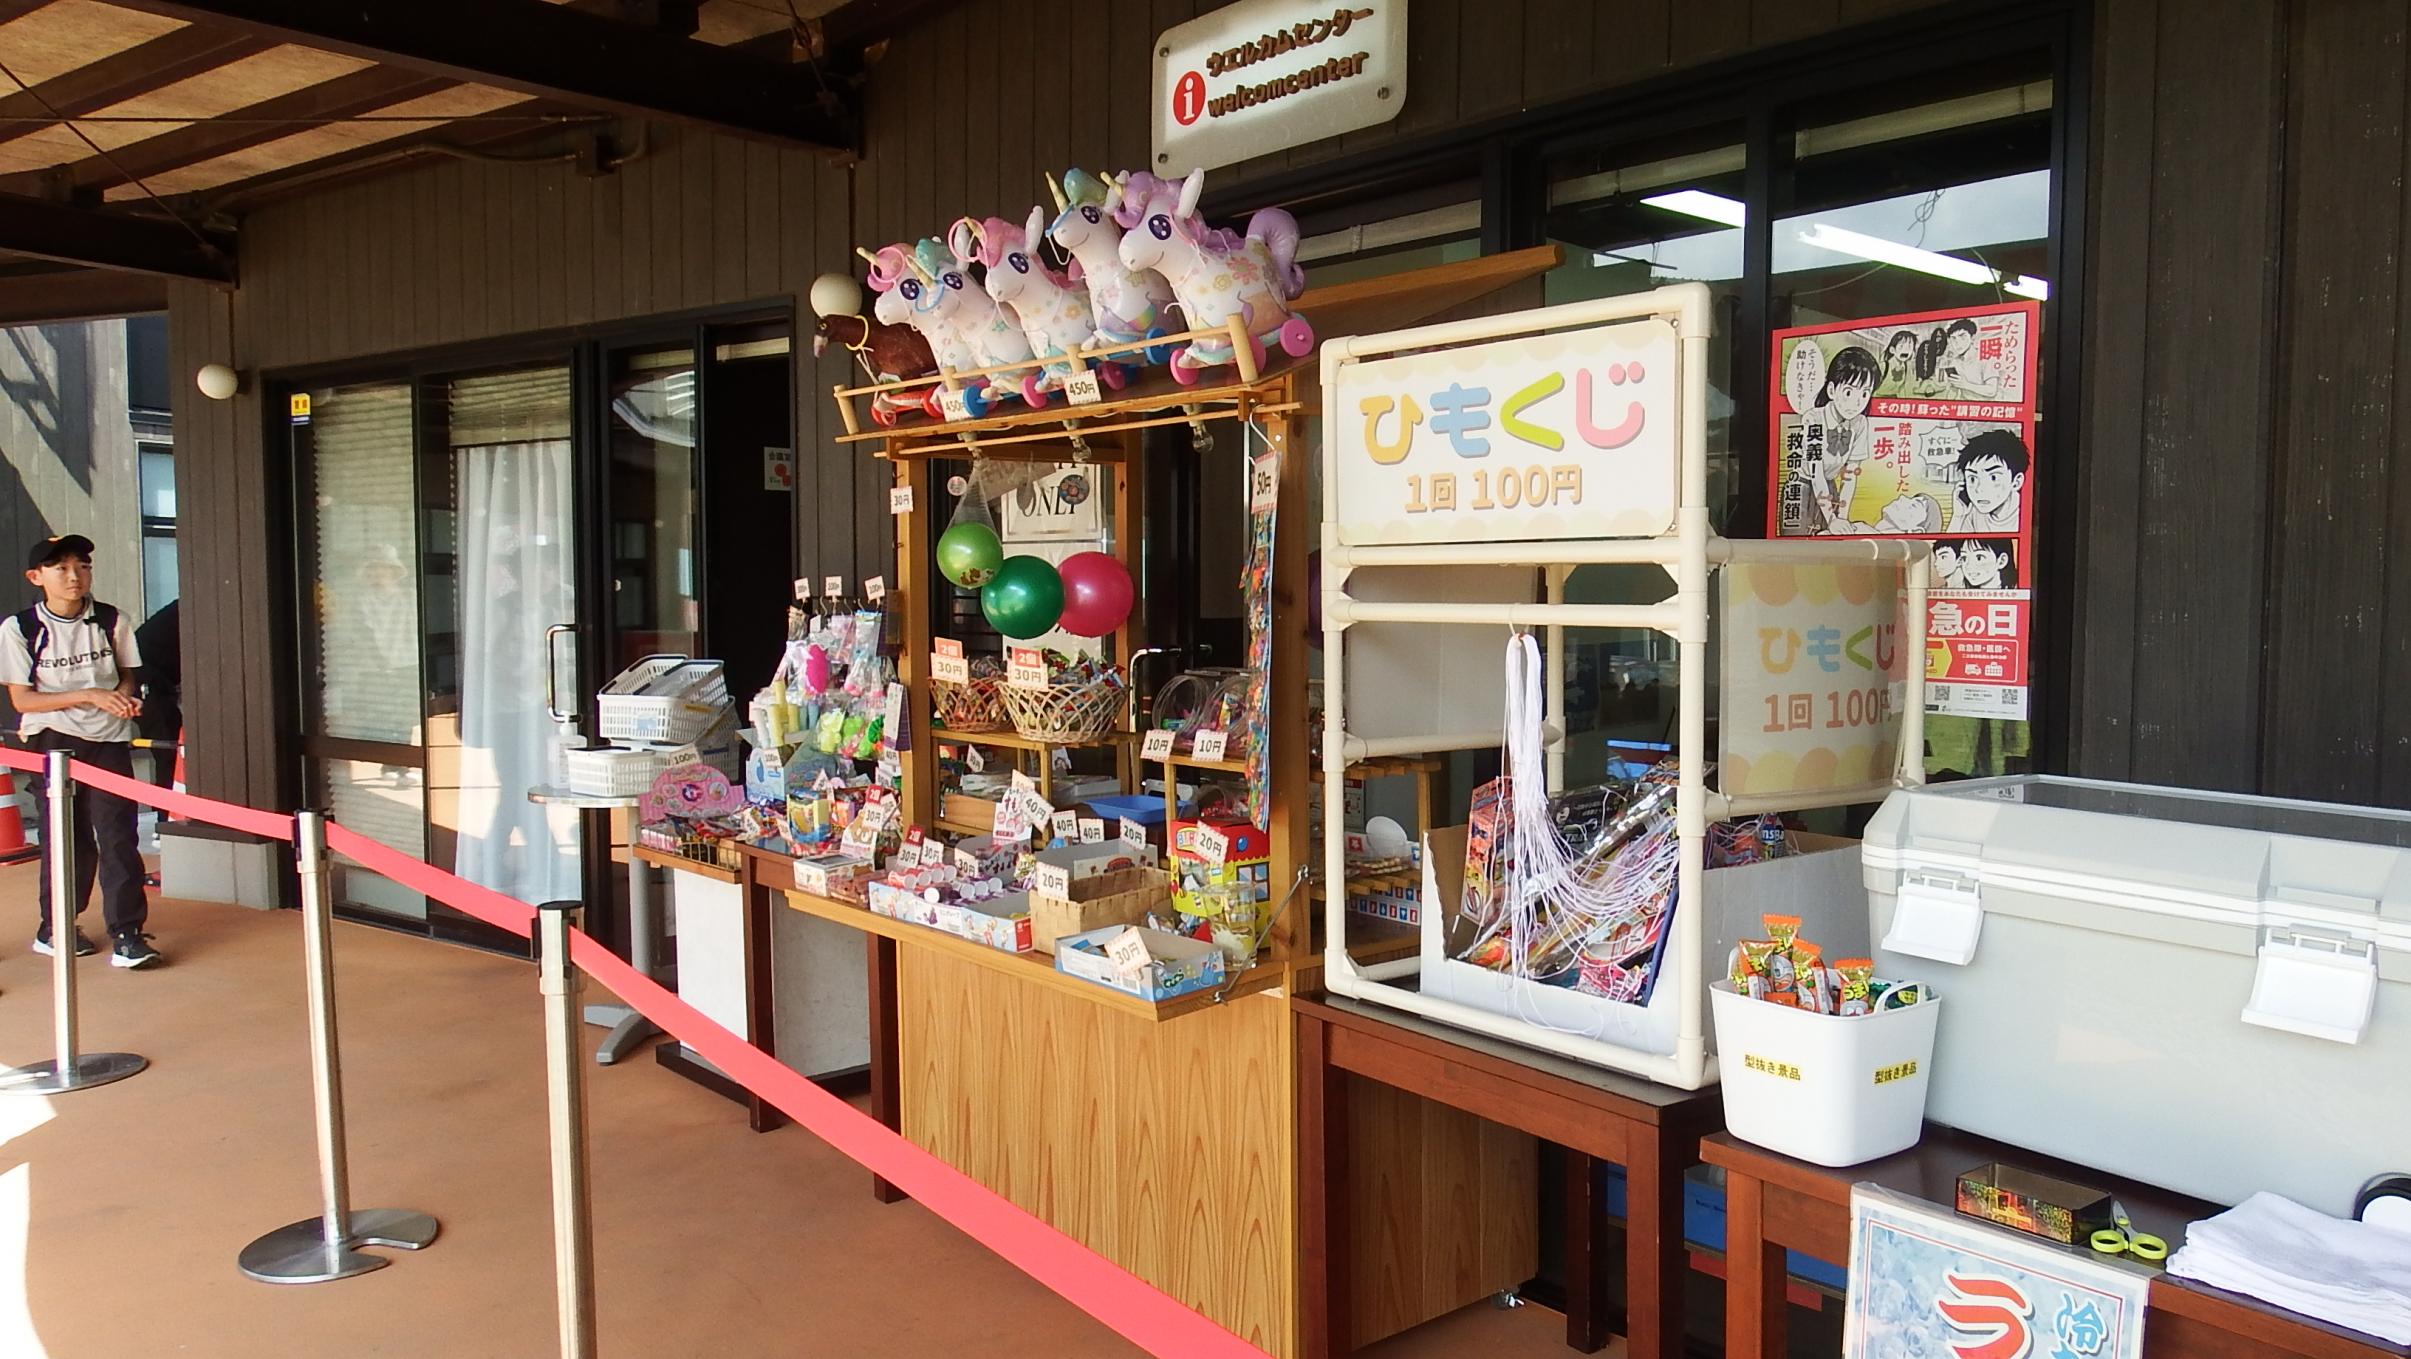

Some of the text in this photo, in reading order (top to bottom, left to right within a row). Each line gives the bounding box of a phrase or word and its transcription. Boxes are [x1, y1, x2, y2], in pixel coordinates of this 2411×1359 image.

[1206, 7, 1374, 77] ウエルカムセンター
[1207, 51, 1369, 118] welcomcenter
[2003, 320, 2019, 388] ためらった
[1068, 381, 1096, 396] 450円
[945, 400, 964, 413] 450
[1359, 360, 1645, 465] ひもくじ
[1897, 422, 1912, 492] 踏み出した
[1256, 470, 1272, 496] 50円
[1783, 423, 1804, 529] 「救命の連鎖」
[1404, 463, 1583, 513] 1回 100円
[893, 494, 910, 507] 30円
[1928, 601, 2017, 636] 急の日
[1758, 623, 1895, 675] ひもくじ
[937, 661, 963, 676] 30円
[1014, 668, 1042, 683] 30円
[1763, 693, 1813, 733] 1回
[1147, 738, 1169, 752] 10円
[1199, 739, 1222, 753] 10円
[673, 752, 697, 764] 100円
[865, 809, 881, 824] 30円
[1025, 798, 1047, 821] 40円
[1056, 819, 1074, 829] 40円
[1083, 827, 1100, 840] 40円
[1123, 825, 1143, 844] 20円
[924, 844, 940, 861] 30円
[1199, 832, 1223, 857] 20円
[900, 850, 917, 864] 30円
[958, 858, 976, 875] 30円
[1041, 873, 1064, 891] 20円
[1115, 942, 1141, 966] 30円
[1744, 1054, 1801, 1081] 型抜き景品
[1874, 1061, 1917, 1084] 型抜き景品
